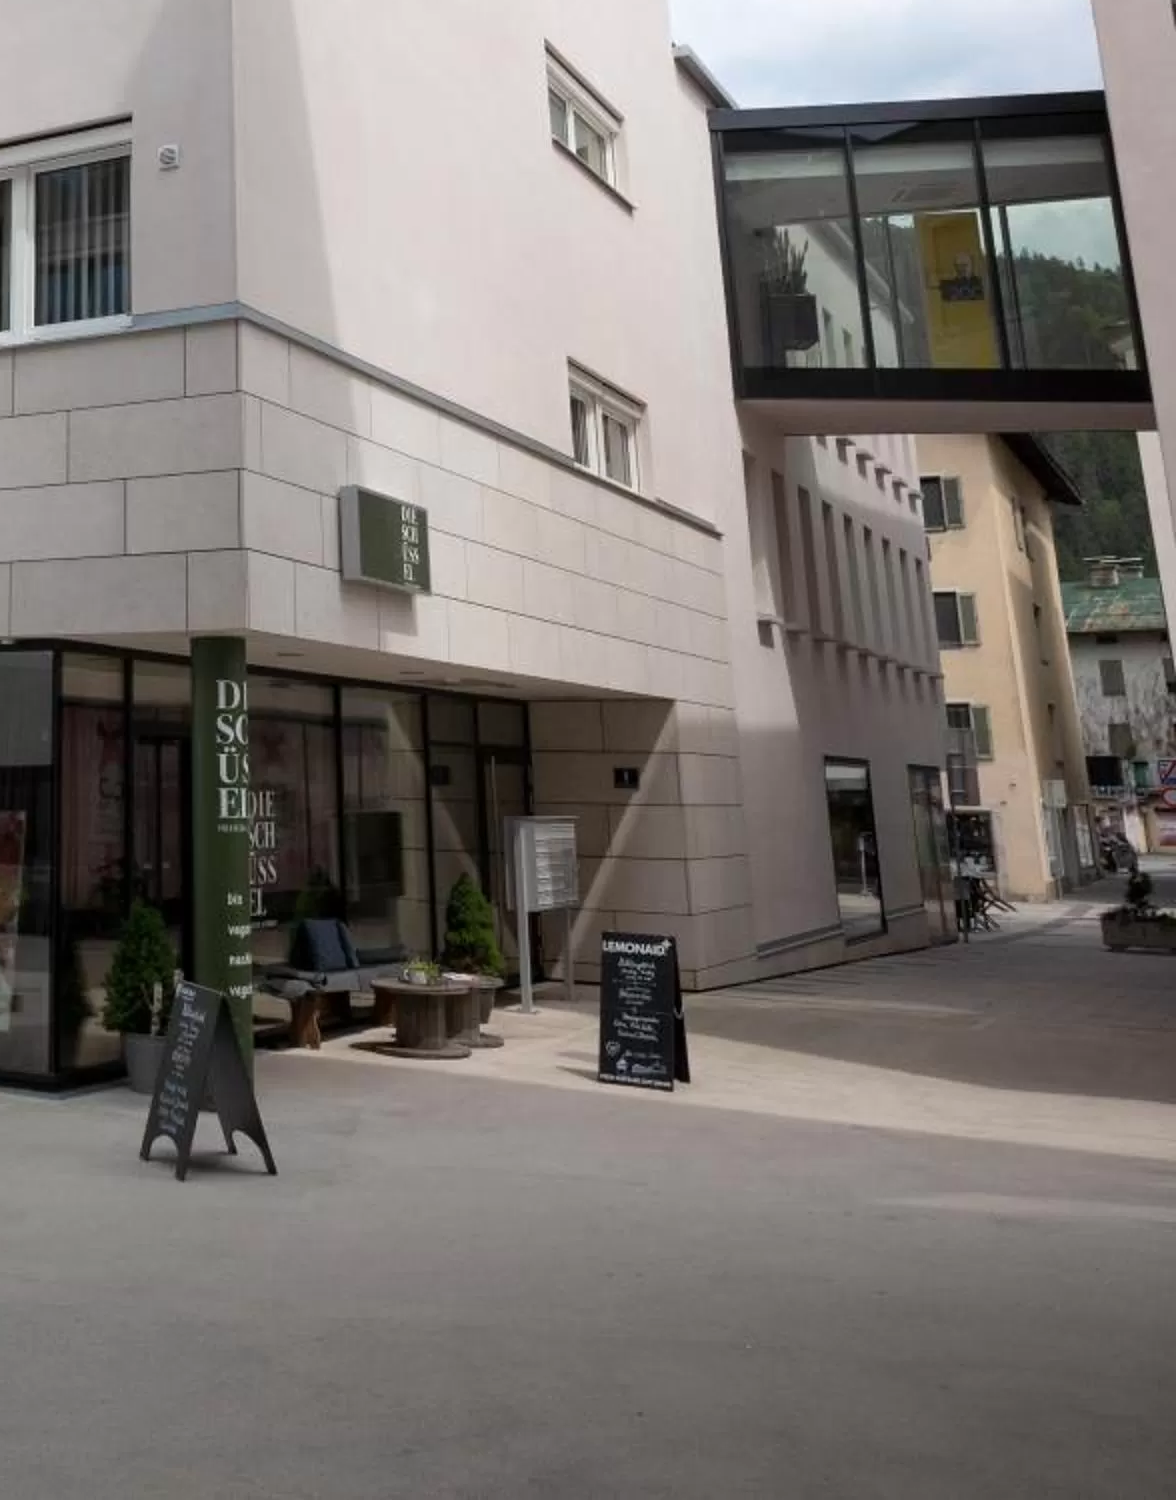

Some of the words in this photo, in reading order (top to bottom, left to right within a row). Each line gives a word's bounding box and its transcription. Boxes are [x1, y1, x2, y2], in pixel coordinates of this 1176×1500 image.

[401, 505, 417, 525] DIE
[402, 523, 419, 544] SCH
[404, 563, 416, 581] EL
